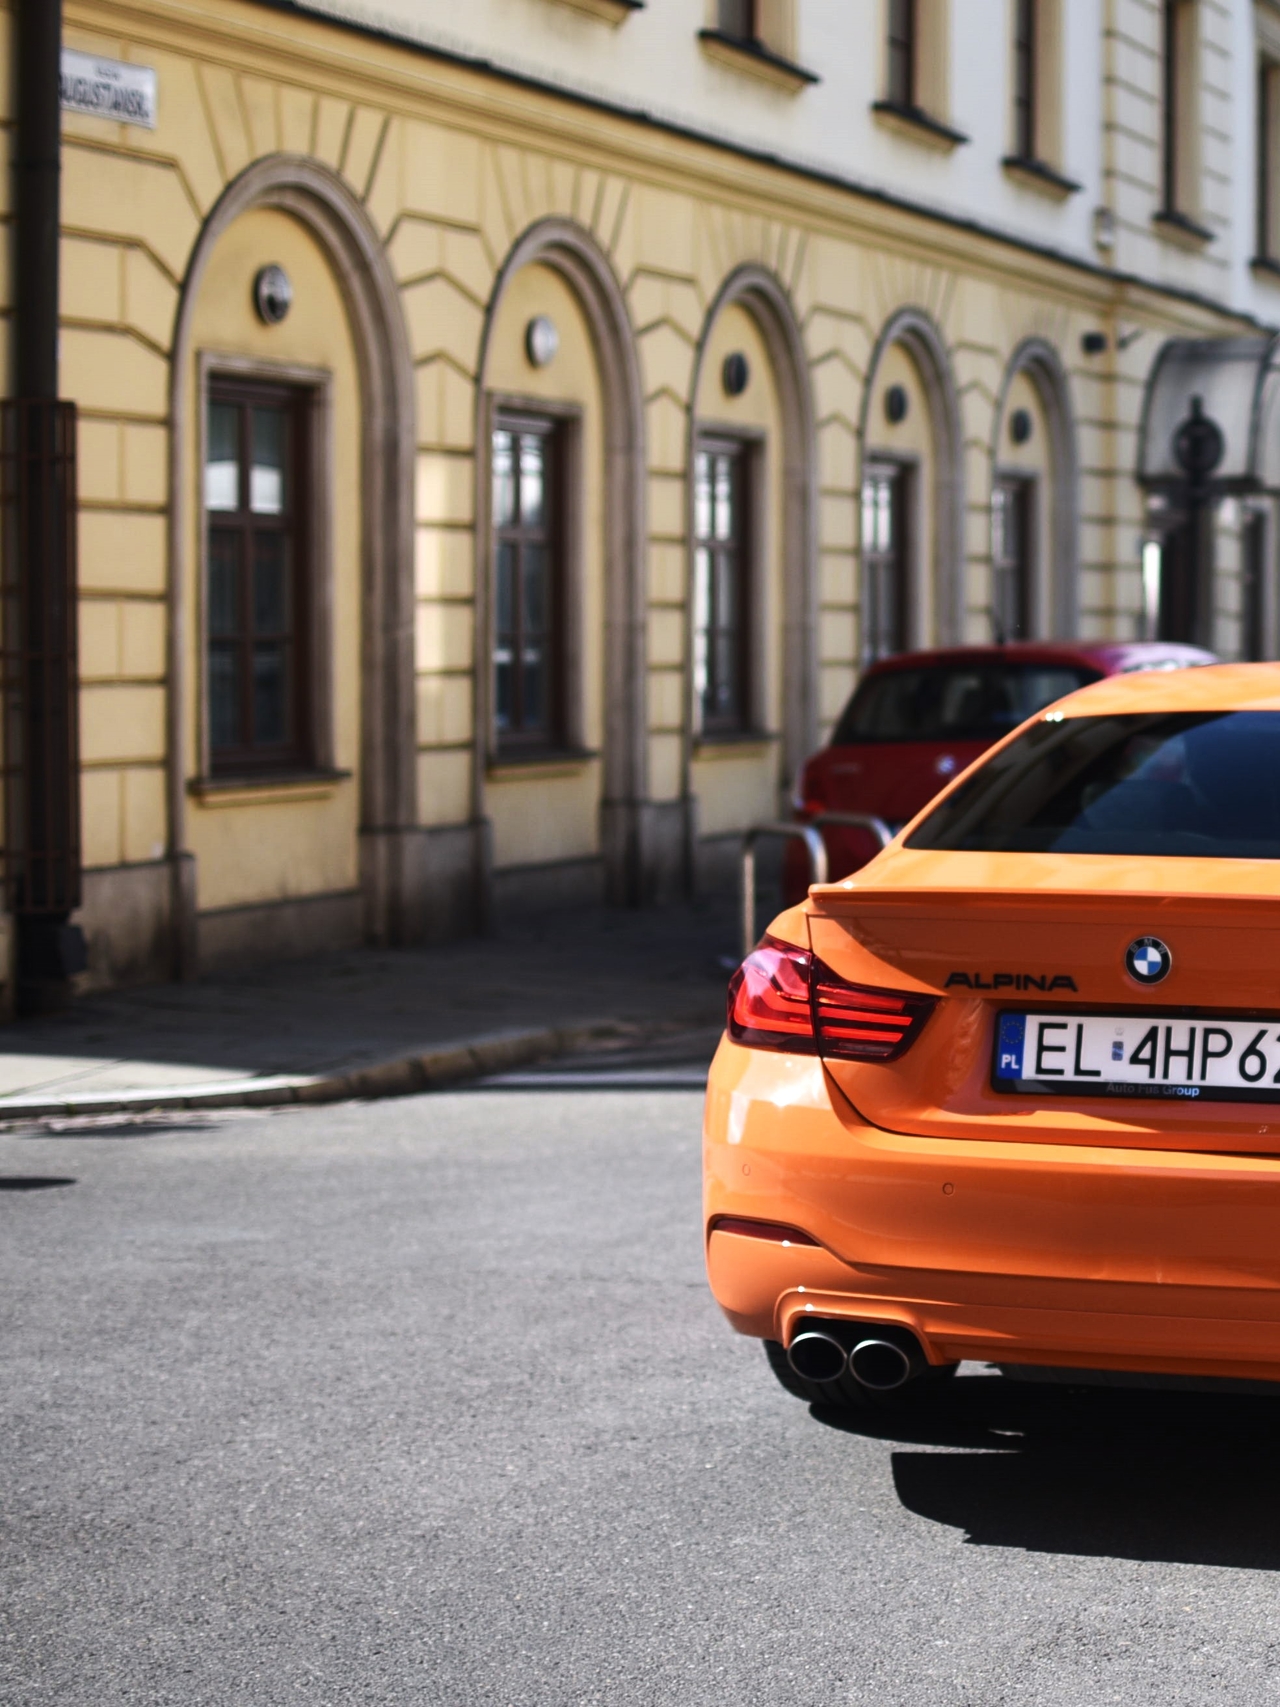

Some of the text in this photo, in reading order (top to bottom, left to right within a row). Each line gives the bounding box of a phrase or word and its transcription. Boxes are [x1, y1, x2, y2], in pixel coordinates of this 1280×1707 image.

[943, 972, 1079, 992] ALPINA
[1035, 1022, 1102, 1077] EL
[1001, 1054, 1020, 1069] PL
[1106, 1082, 1135, 1093] Auto
[1162, 1085, 1200, 1097] Group
